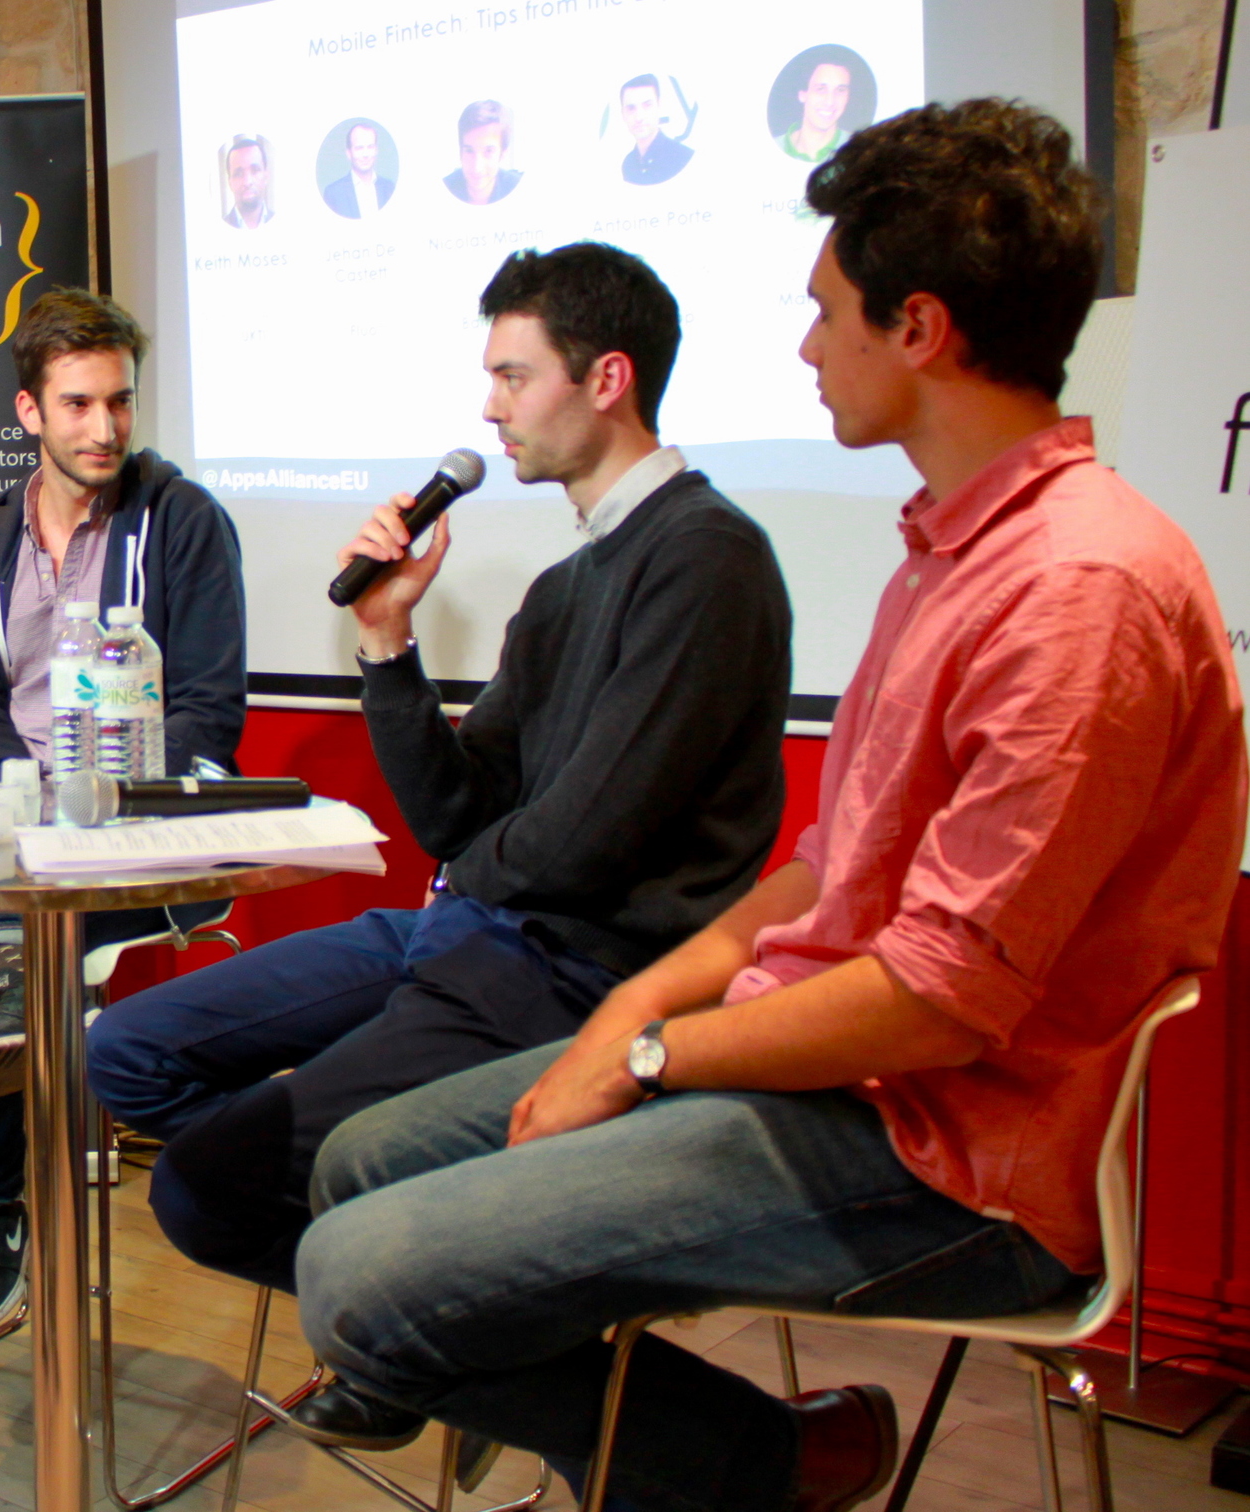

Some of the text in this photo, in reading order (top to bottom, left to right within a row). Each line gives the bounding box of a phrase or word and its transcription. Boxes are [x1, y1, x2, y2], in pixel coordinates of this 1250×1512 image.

[308, 31, 377, 58] Mobile
[476, 7, 518, 32] Tips
[592, 209, 713, 233] Antoine Porte
[375, 243, 396, 258] De
[428, 228, 545, 251] Nicolas Martin
[193, 252, 288, 272] Keith Moses
[201, 468, 369, 492] @AppsAllianceEU
[101, 689, 141, 705] PINS
